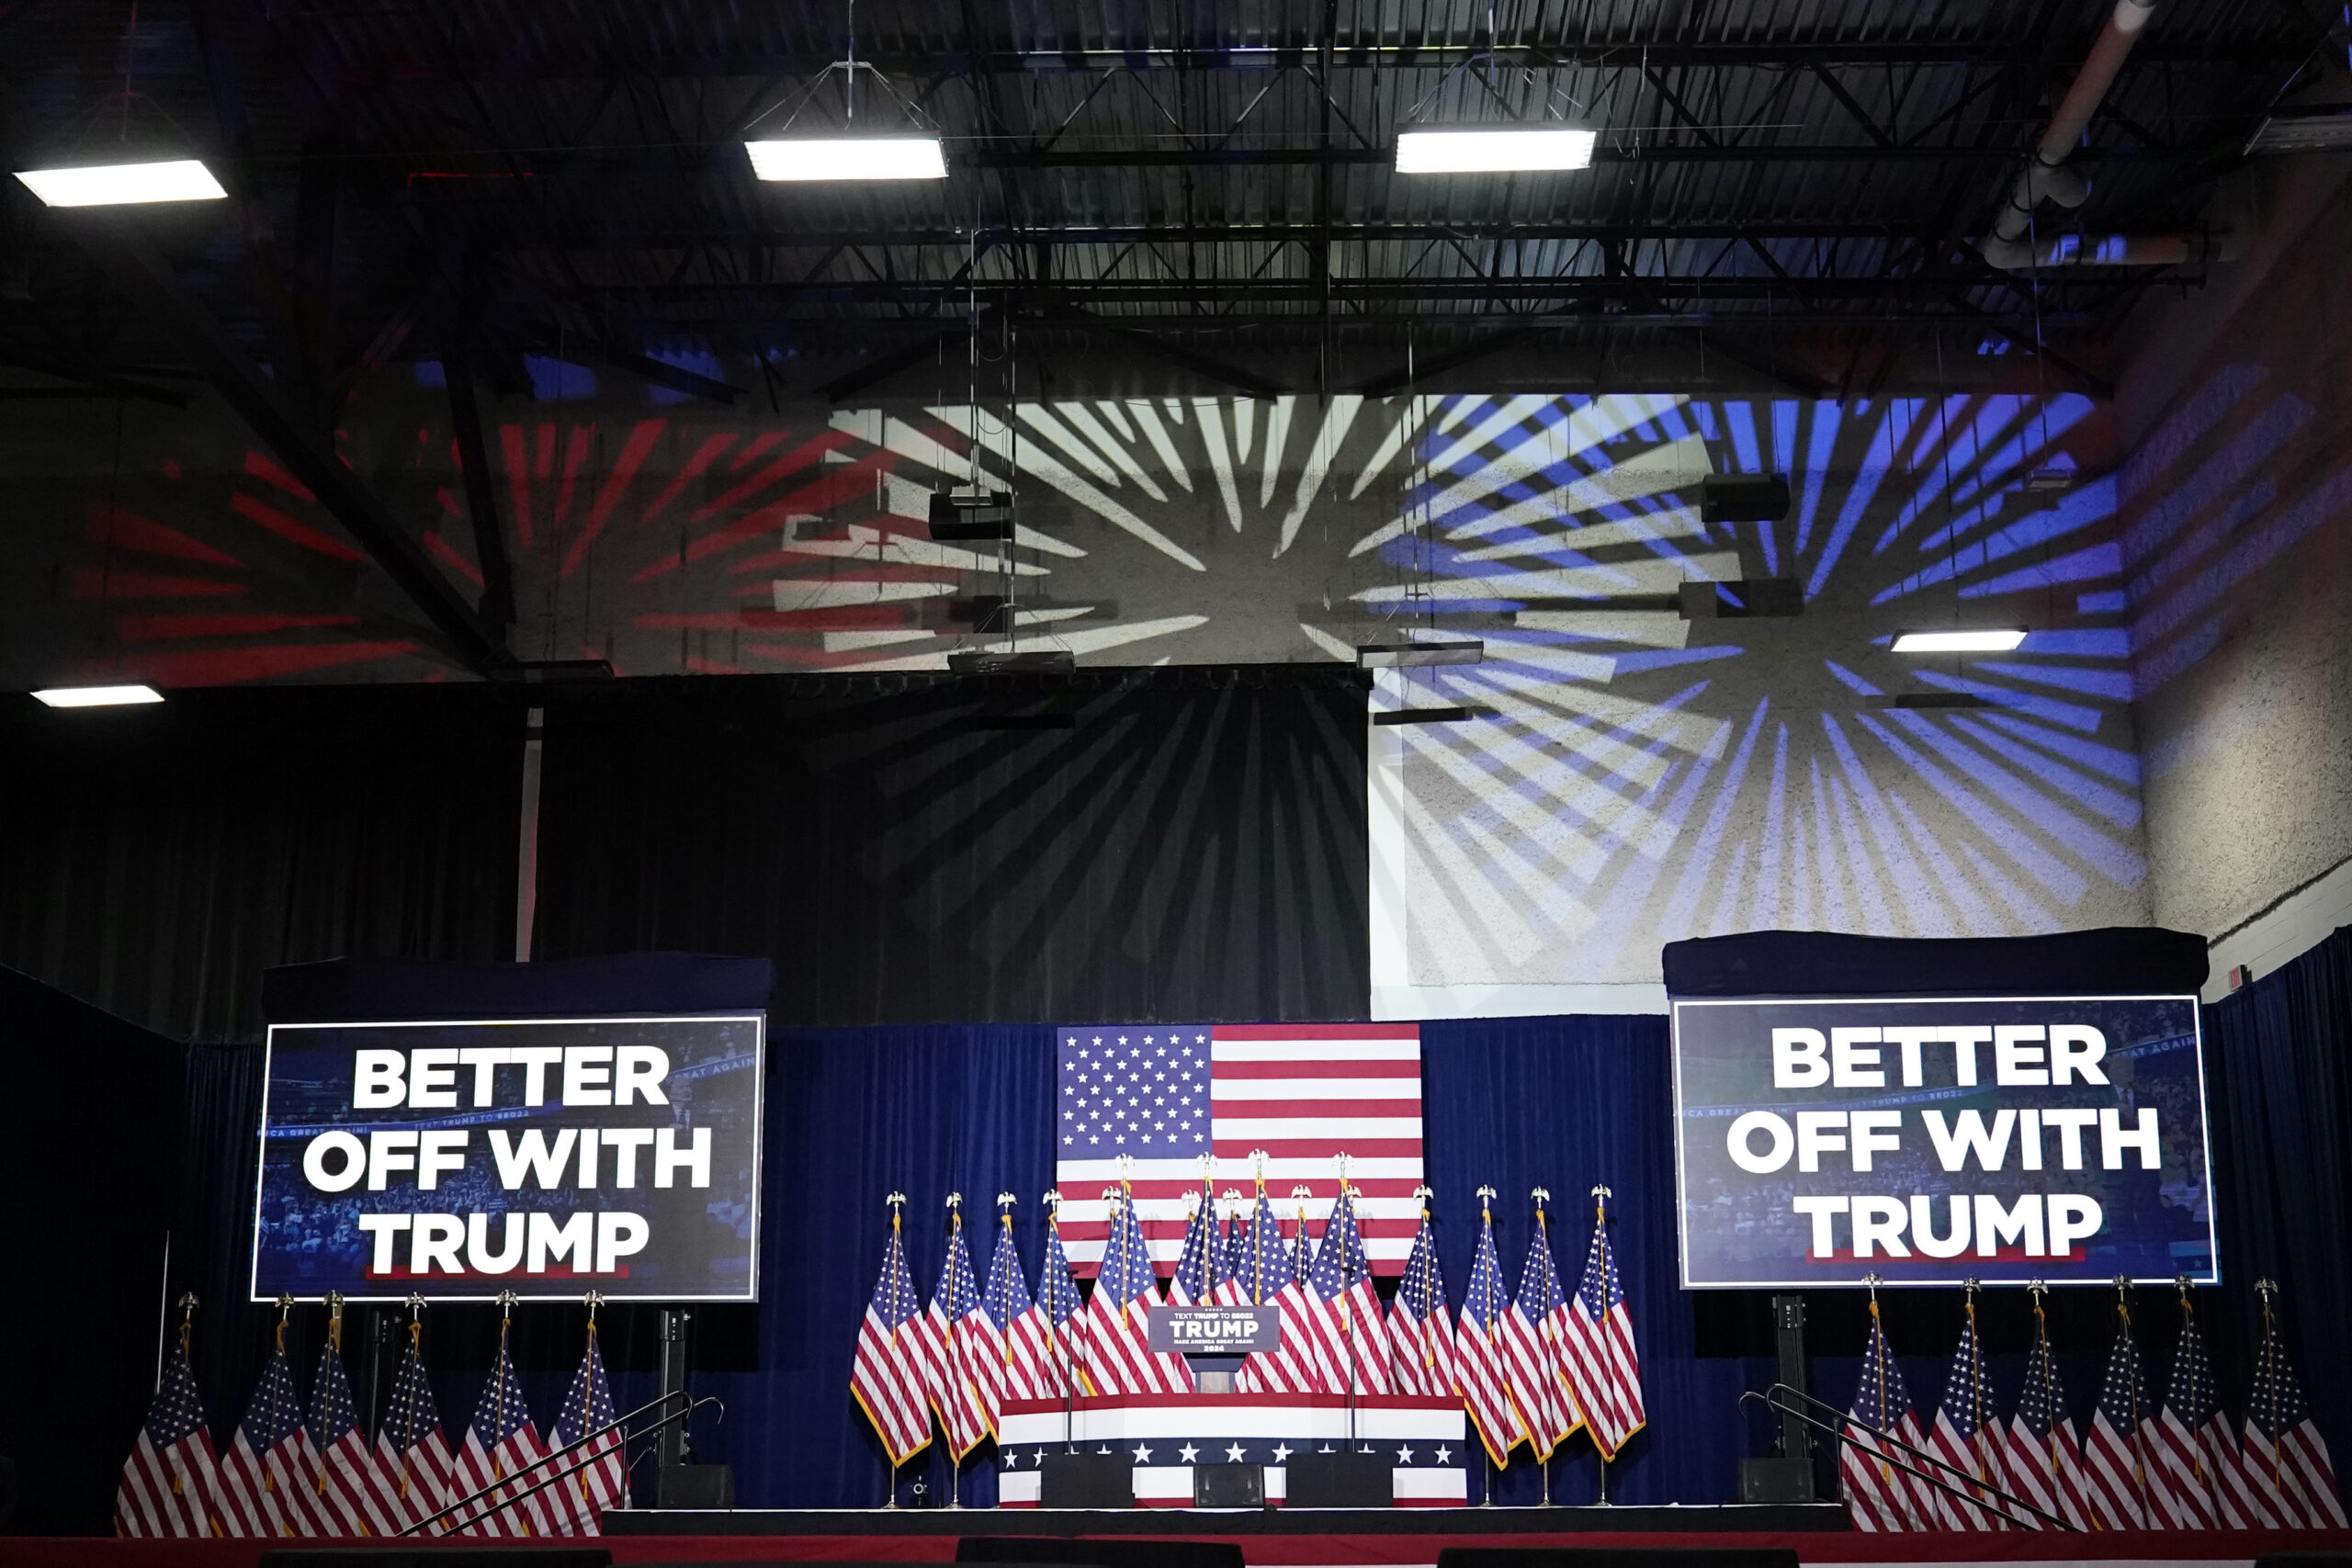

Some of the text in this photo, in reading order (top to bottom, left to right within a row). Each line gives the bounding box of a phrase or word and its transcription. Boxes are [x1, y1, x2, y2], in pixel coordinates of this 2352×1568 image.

[353, 1045, 670, 1109] BETTER
[1771, 1024, 2110, 1089] BETTER
[303, 1127, 711, 1192] OFF WITH
[1726, 1108, 2161, 1174] OFF WITH
[358, 1212, 650, 1274] TRUMP
[1792, 1194, 2102, 1258] TRUMP
[1169, 1320, 1259, 1337] TRUMP
